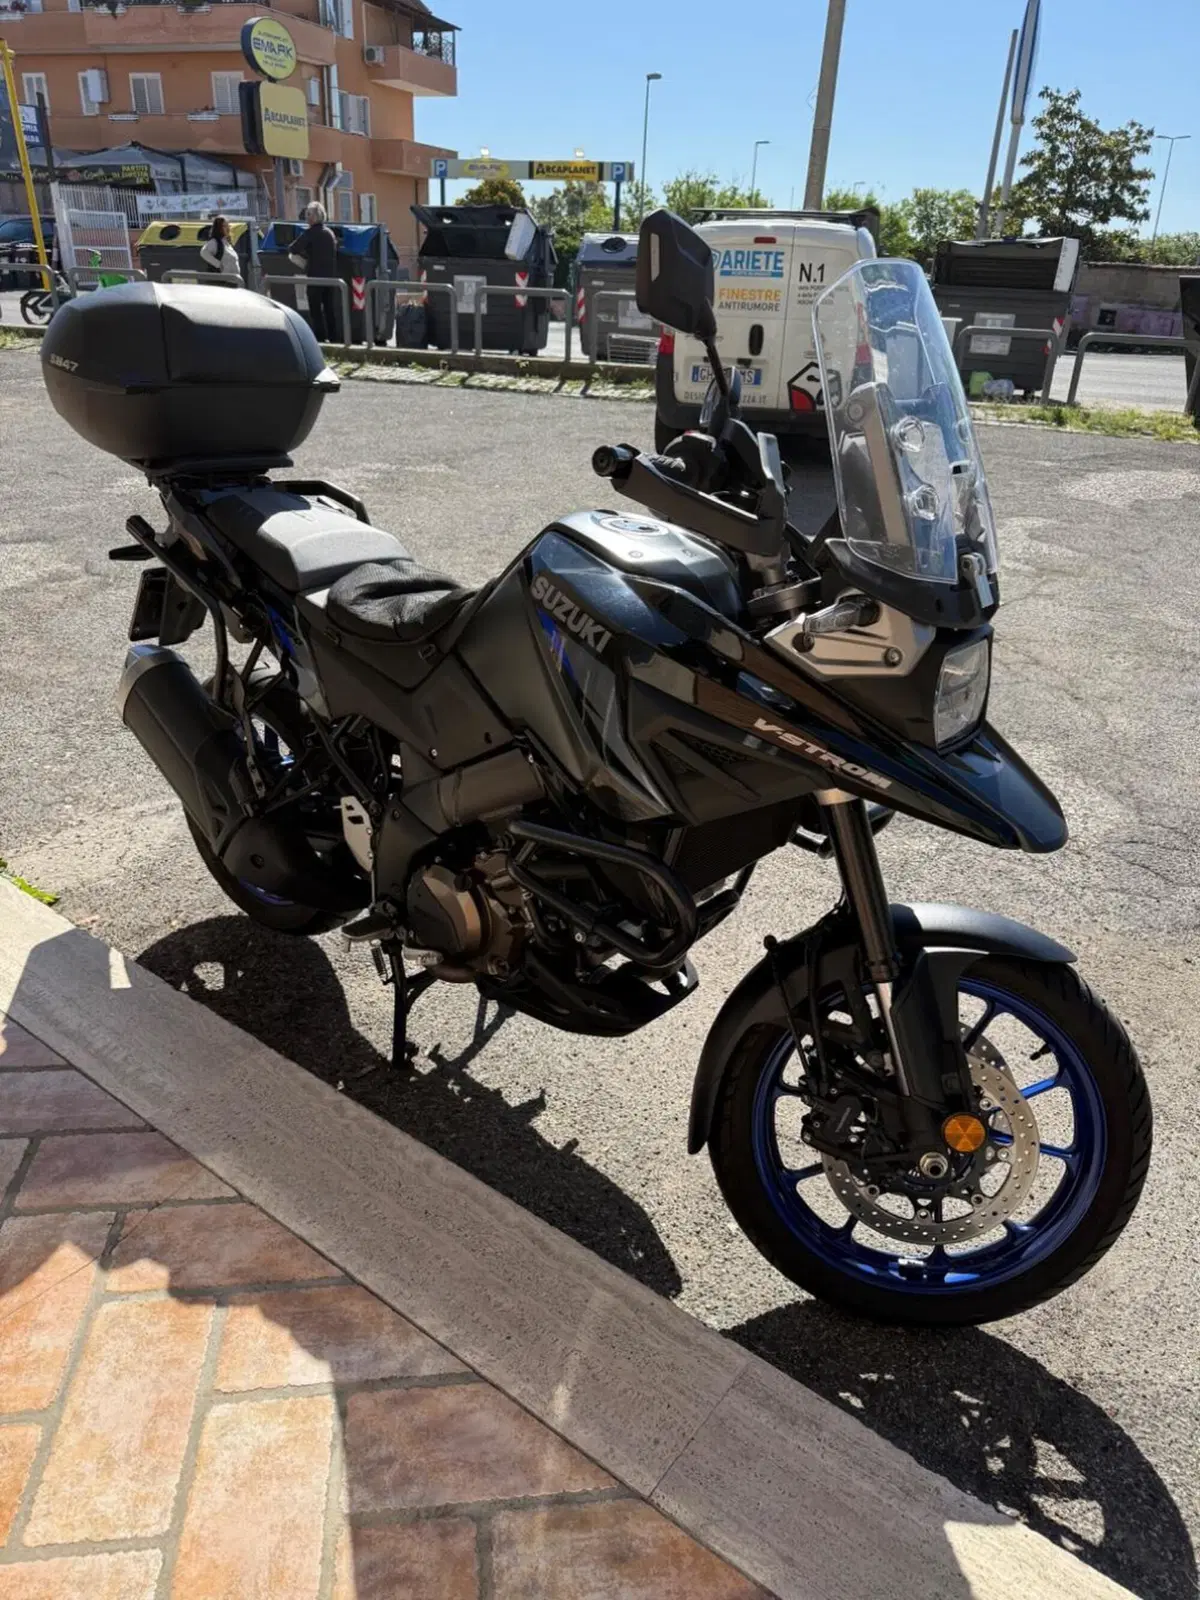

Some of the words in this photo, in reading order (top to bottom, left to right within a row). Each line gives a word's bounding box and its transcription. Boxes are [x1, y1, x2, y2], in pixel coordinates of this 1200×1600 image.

[252, 37, 293, 58] EMARK
[264, 106, 305, 127] ARCAPLANET
[536, 163, 596, 175] ARCAPLANET
[720, 250, 784, 270] ARIETE
[799, 263, 825, 282] N.1
[719, 288, 781, 301] FINESTRE
[718, 302, 780, 311] ANTIRUMORE
[531, 576, 612, 653] SUZUKI
[754, 718, 892, 789] V-STROM
